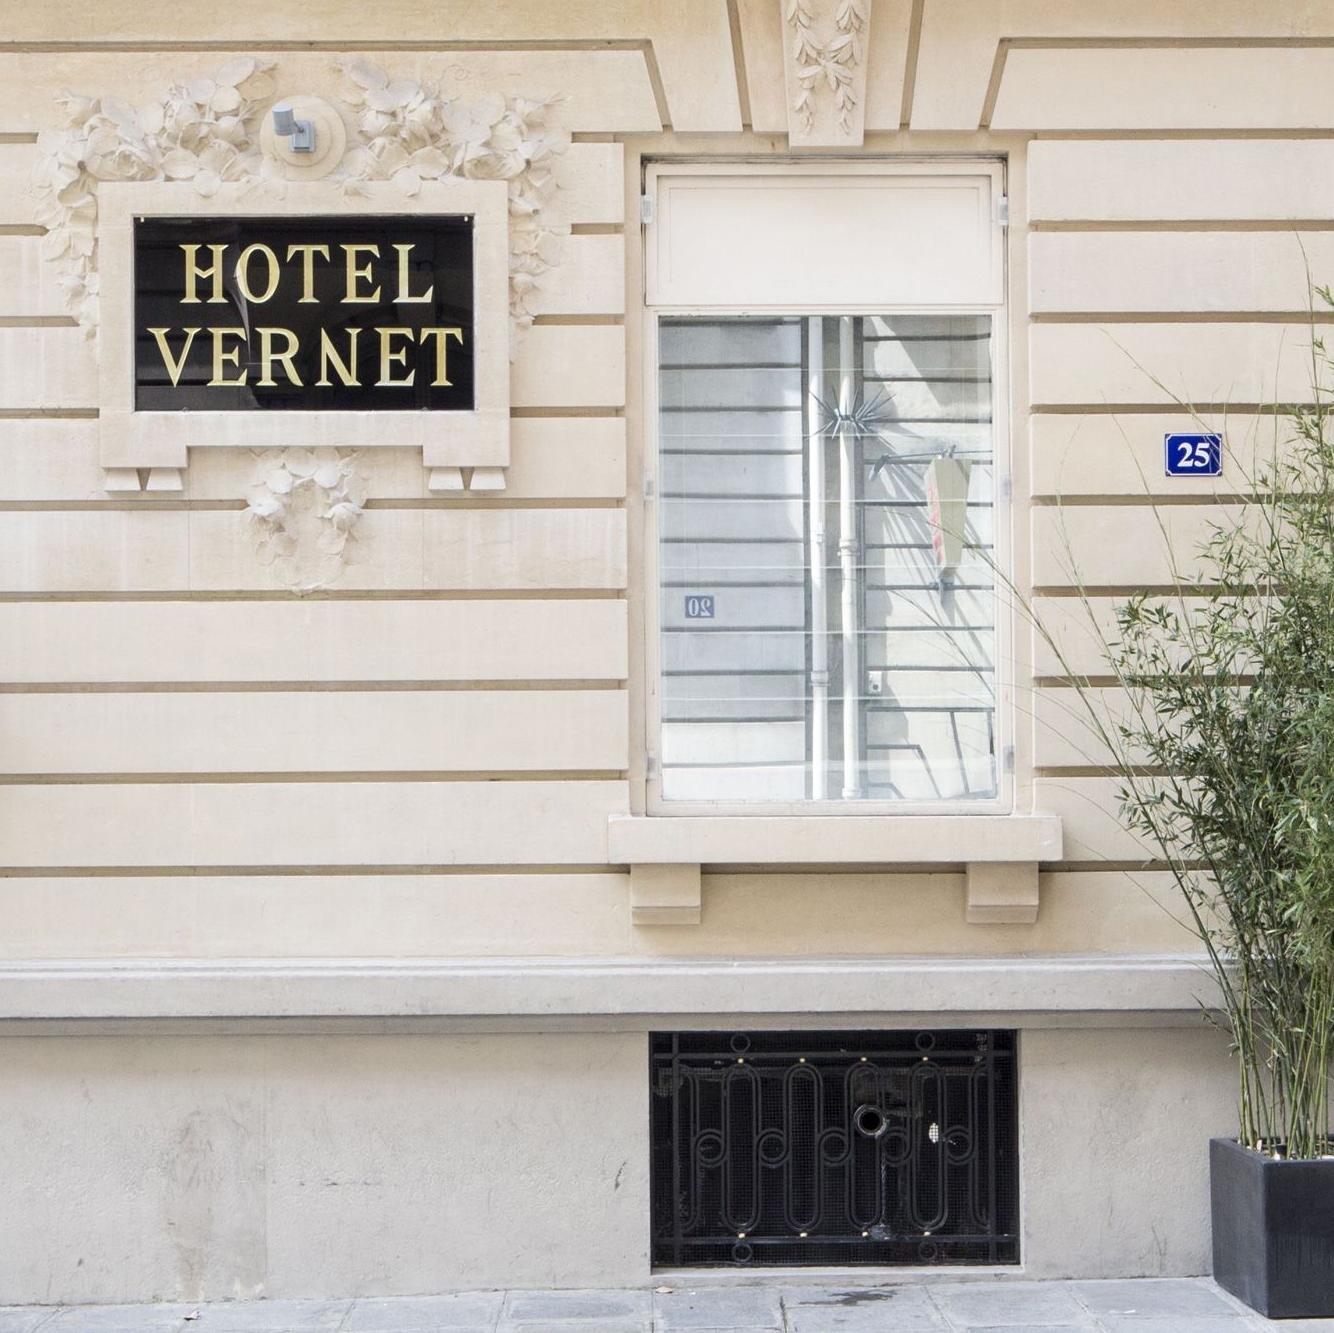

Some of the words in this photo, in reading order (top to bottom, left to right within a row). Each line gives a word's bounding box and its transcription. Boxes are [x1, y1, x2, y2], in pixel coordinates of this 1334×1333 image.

[178, 242, 434, 304] HOTEL
[146, 326, 464, 388] VERNET
[1176, 441, 1211, 468] 25
